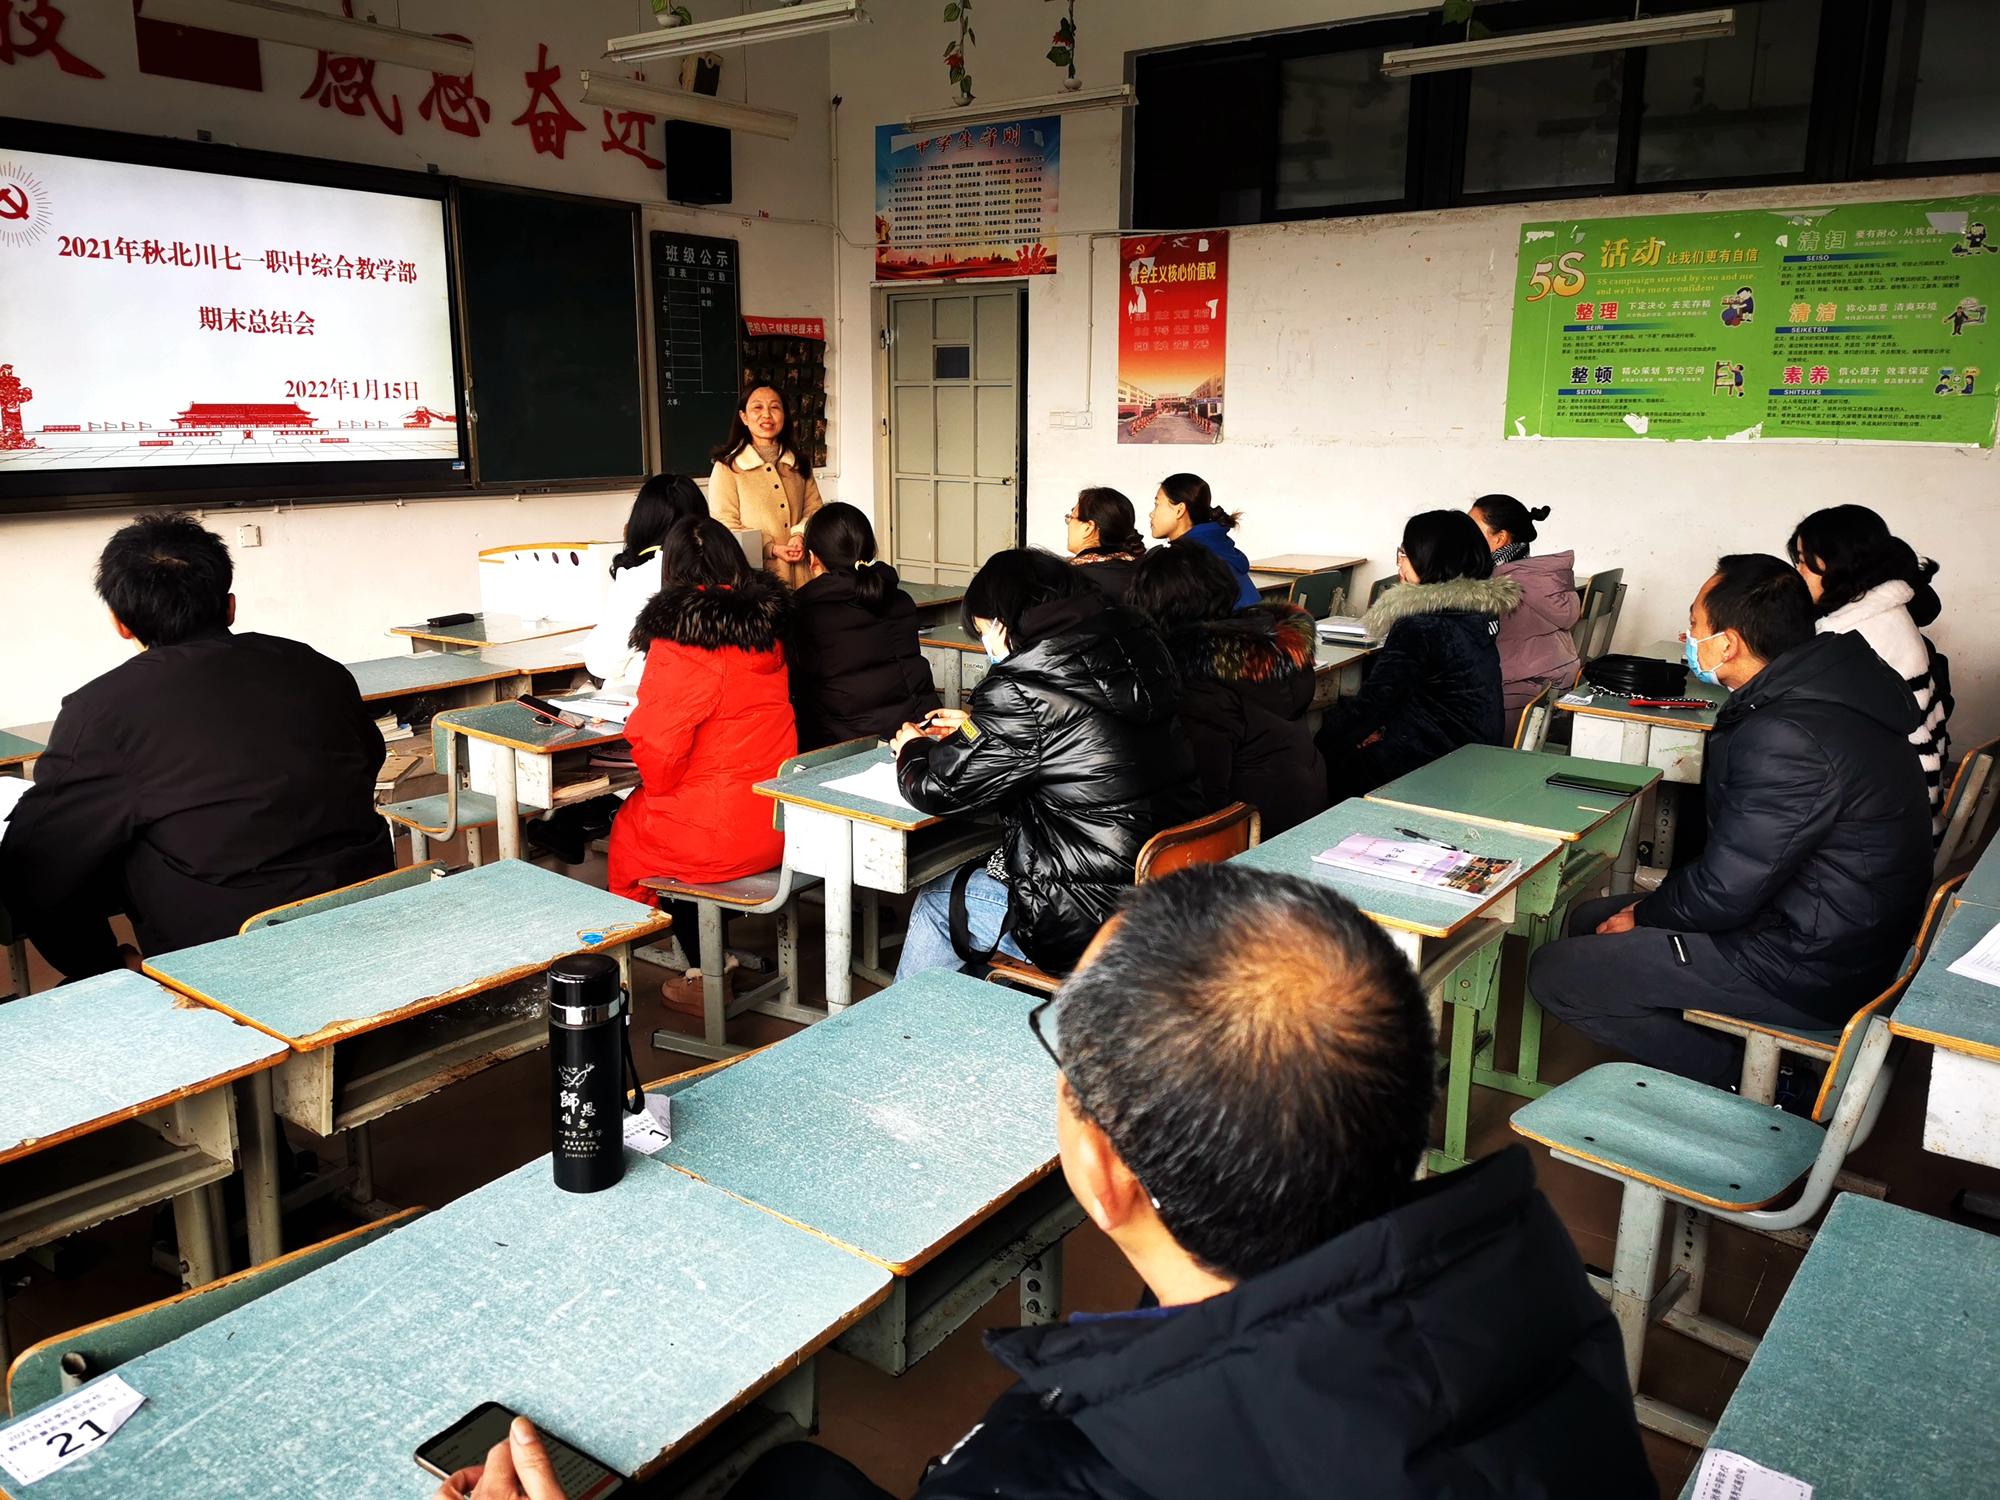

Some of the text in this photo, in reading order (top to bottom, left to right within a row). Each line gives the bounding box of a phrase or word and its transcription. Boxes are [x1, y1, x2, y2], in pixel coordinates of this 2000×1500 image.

[914, 123, 1022, 156] 中学生守则
[1797, 230, 1847, 251] 清扫
[57, 235, 418, 284] 2021年秋北川七一职中综合教学部
[665, 245, 729, 267] 班级公示
[1600, 237, 1759, 269] 活动 让我们更有自信
[1526, 250, 1586, 302] 5S
[1657, 274, 1688, 284] started
[1690, 273, 1700, 285] by
[1702, 274, 1719, 284] you
[1721, 272, 1737, 281] and
[1596, 287, 1611, 295] and
[1636, 286, 1646, 295] be
[1648, 286, 1668, 294] more
[1669, 285, 1714, 293] confident
[198, 305, 315, 336] 期末总结会
[1575, 302, 1619, 321] 整理
[1627, 301, 1666, 310] 下定决心
[1789, 302, 1838, 322] 清洁
[1570, 366, 1613, 384] 整顿
[1666, 366, 1705, 375] 节约空间
[1783, 366, 1830, 385] 素养
[1838, 367, 1881, 376] 信心提升
[284, 377, 420, 401] 2022年1月15日
[46, 1419, 108, 1457] 21
